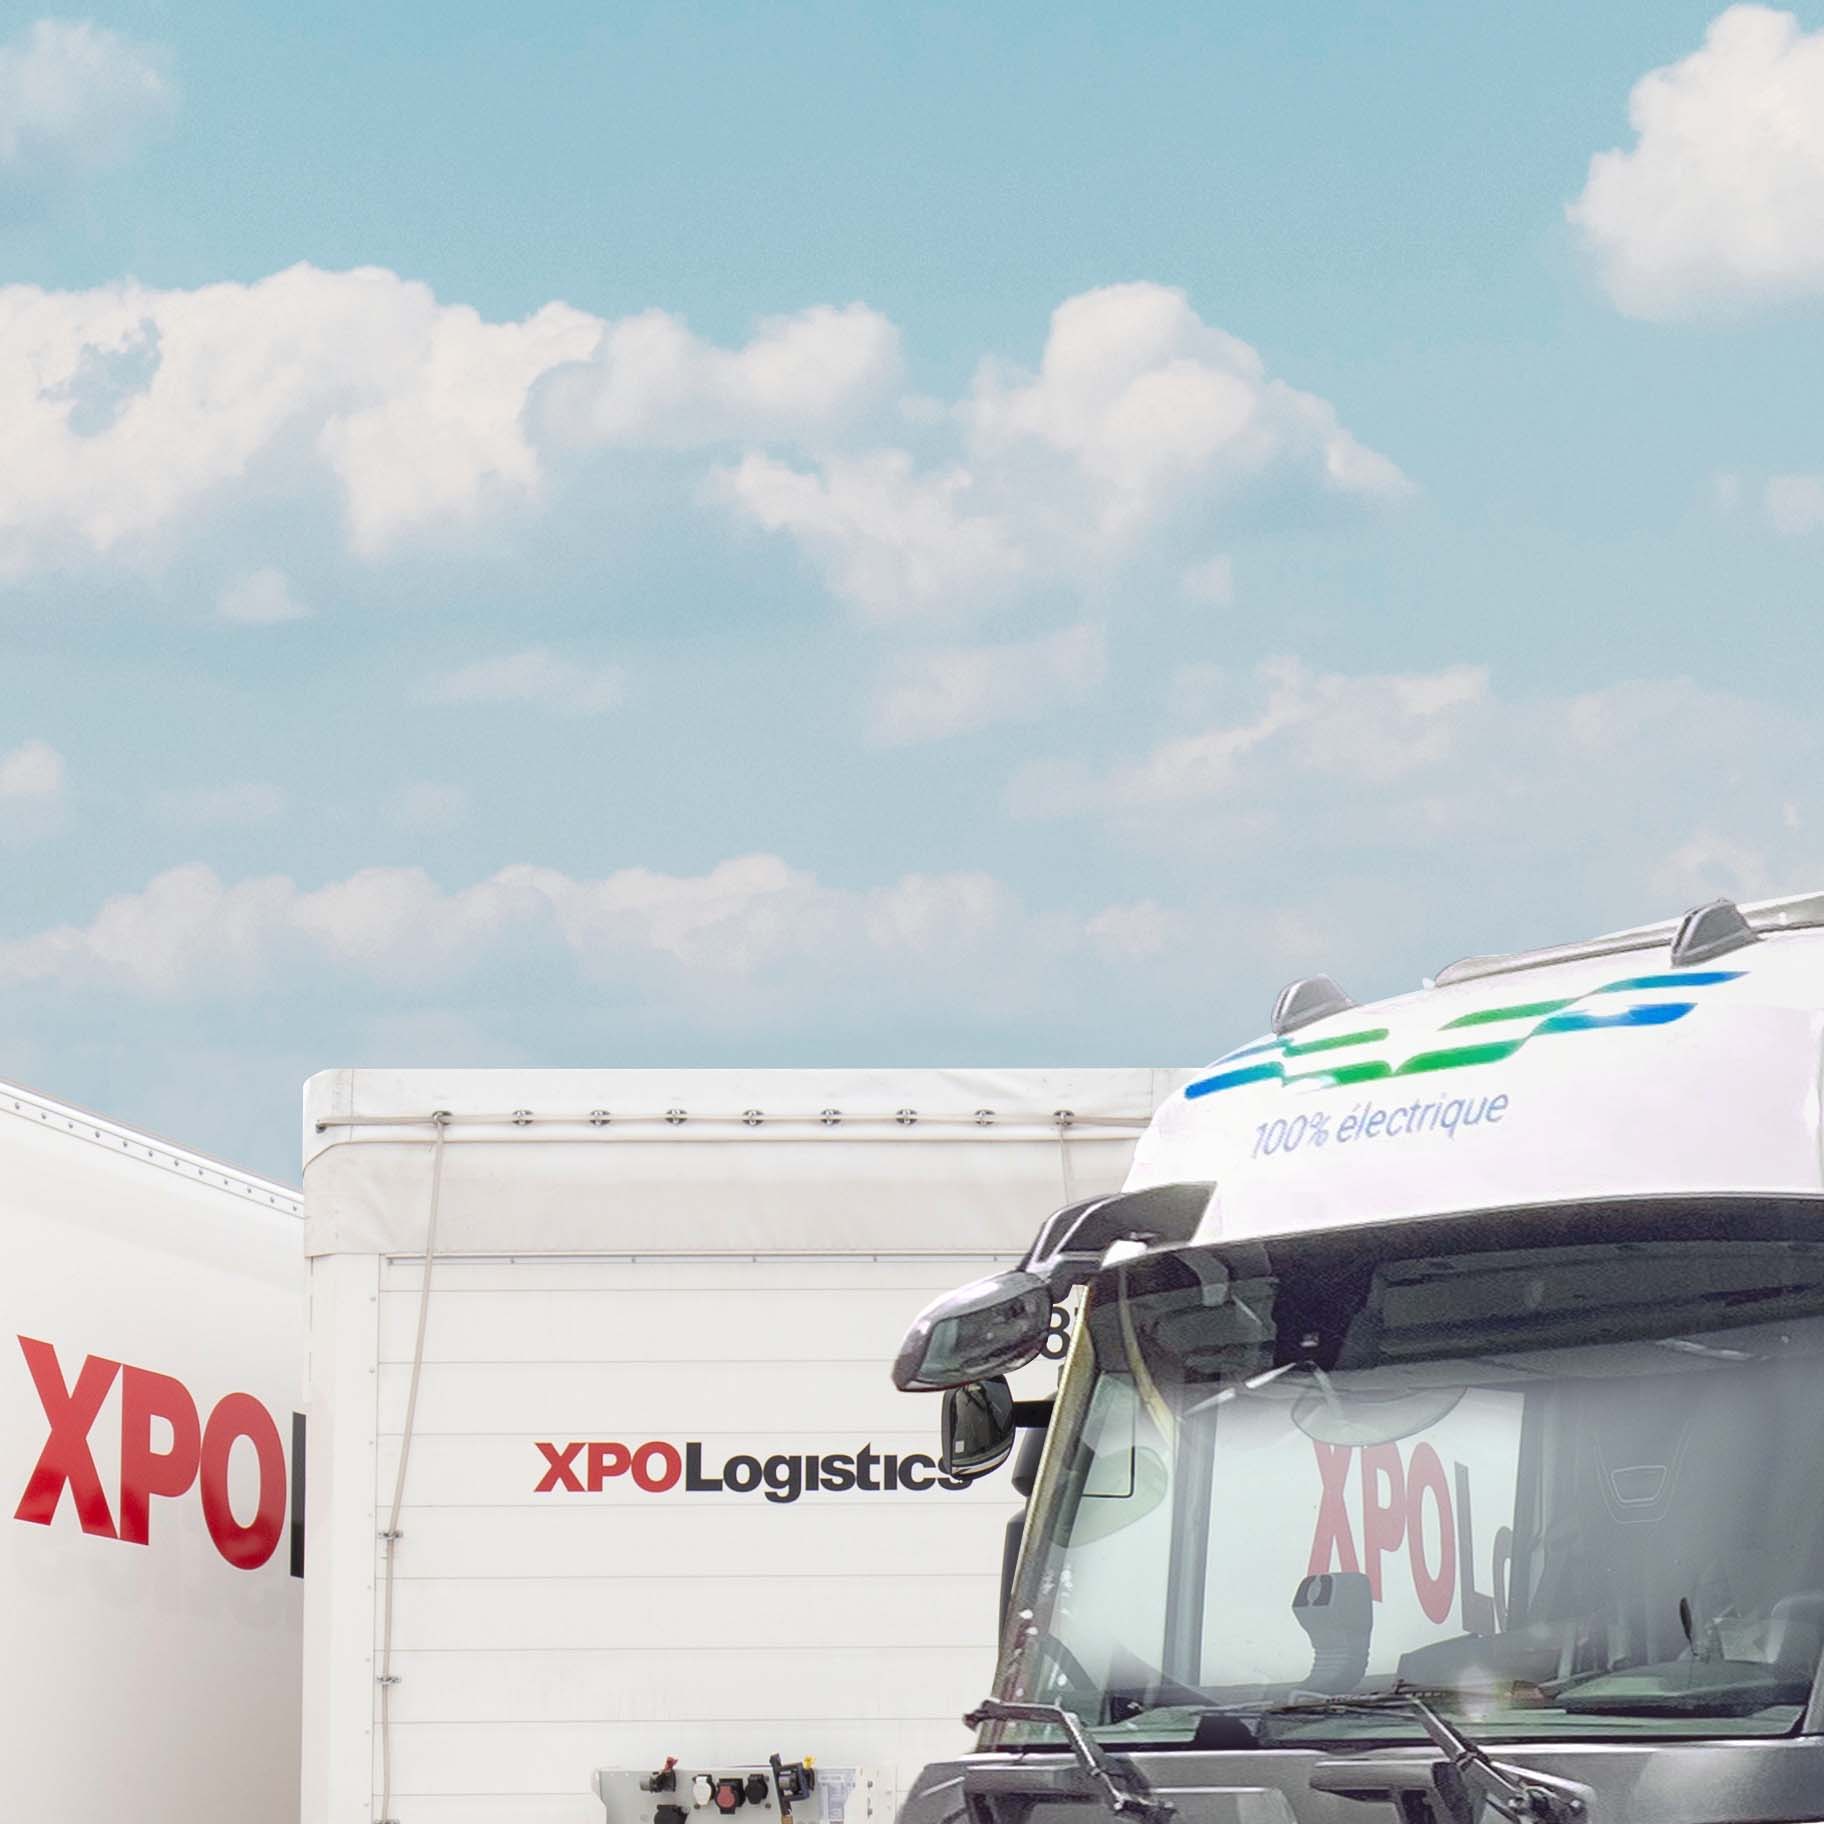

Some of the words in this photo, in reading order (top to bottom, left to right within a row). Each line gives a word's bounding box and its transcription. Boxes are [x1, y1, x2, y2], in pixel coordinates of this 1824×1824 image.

[1250, 1111, 1331, 1159] 100%
[1336, 1091, 1509, 1144] électrique
[14, 1334, 304, 1579] XPO
